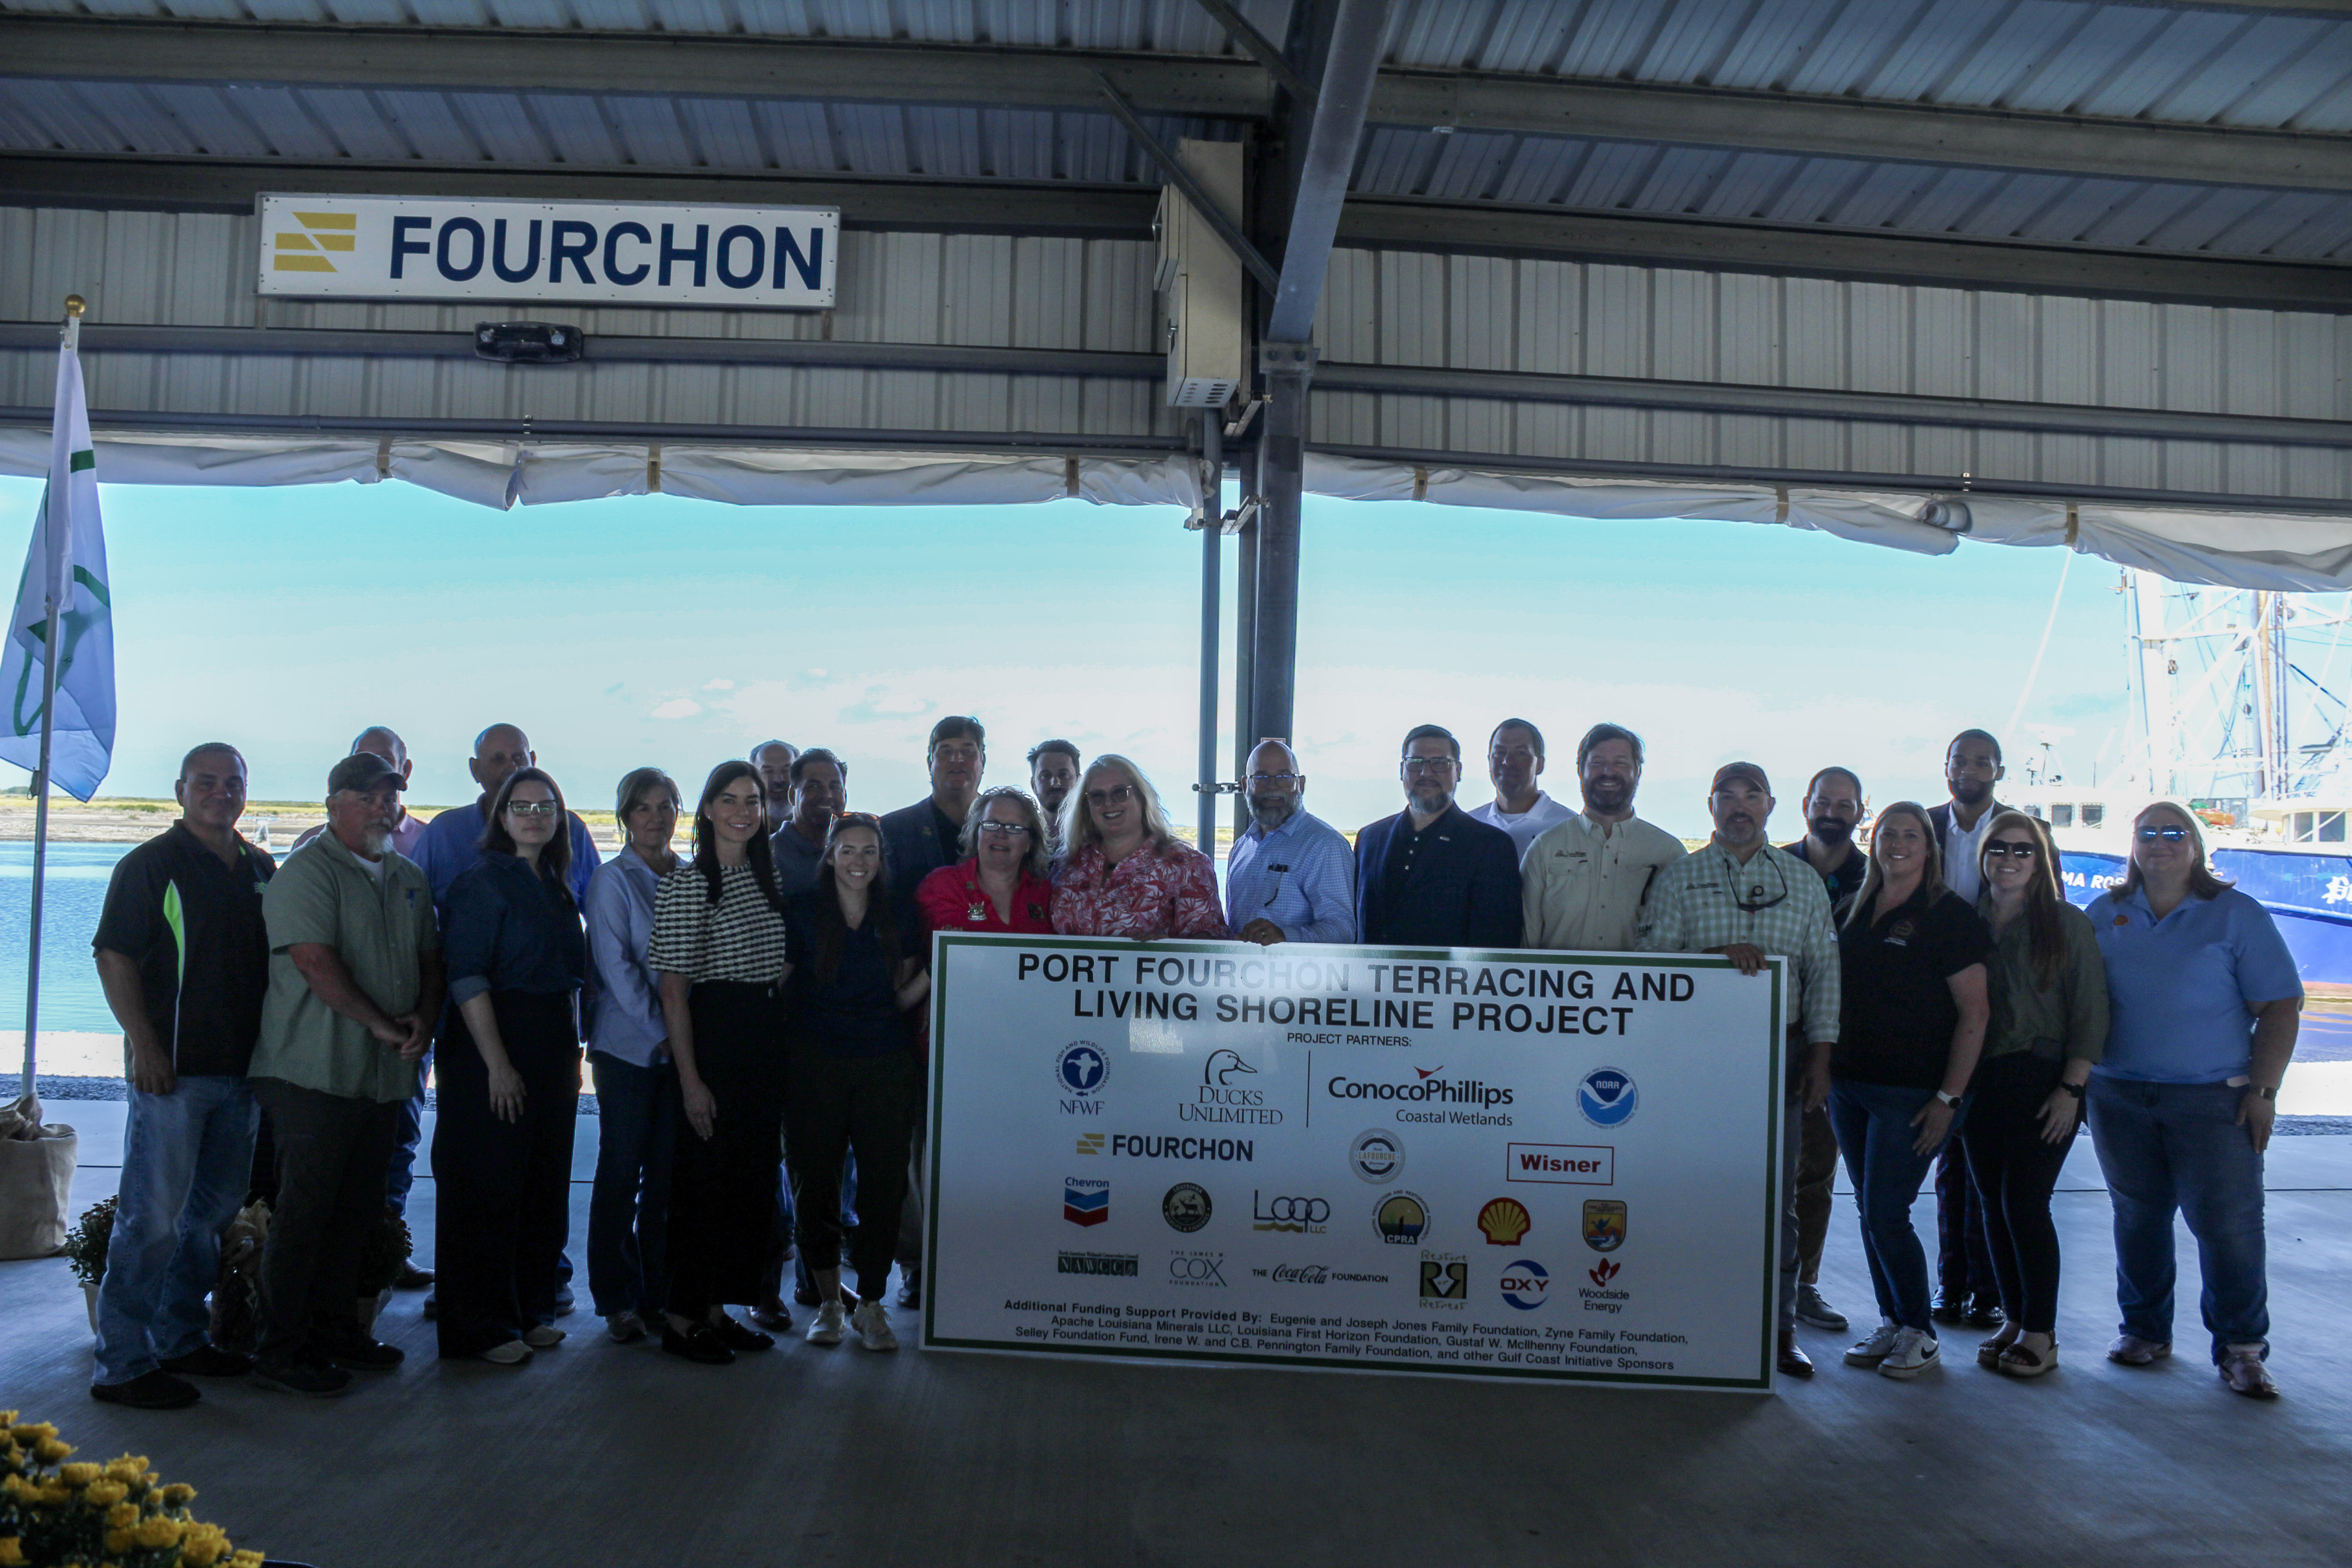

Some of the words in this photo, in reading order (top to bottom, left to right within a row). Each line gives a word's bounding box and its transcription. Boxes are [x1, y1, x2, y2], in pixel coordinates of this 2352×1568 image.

[390, 215, 823, 290] FOURCHON
[1019, 953, 1119, 983] PORT
[1136, 957, 1349, 991] FOURCHON
[1367, 964, 1594, 1000] TERRACING
[1612, 972, 1695, 1002] AND
[1074, 989, 1198, 1021] LIVING
[1215, 994, 1434, 1029] SHORELINE
[1453, 1002, 1633, 1035] PROJECT
[1065, 1041, 1078, 1050] AND
[1079, 1040, 1106, 1056] WILDLIFE
[1287, 1033, 1342, 1044] PROJECT
[1347, 1035, 1412, 1047] PARTNERS:
[1056, 1049, 1065, 1063] FISH
[1055, 1065, 1073, 1094] NATIONAL
[1091, 1057, 1111, 1094] FOUNDATION
[1596, 1080, 1620, 1089] NOAA
[1199, 1086, 1263, 1106] DUCKS
[1328, 1077, 1514, 1110] ConocoPhillips
[1060, 1099, 1105, 1116] NFWF
[1179, 1103, 1283, 1125] UNLIMITED
[1396, 1109, 1446, 1123] Coastal
[1449, 1111, 1513, 1126] Wetlands
[1112, 1134, 1253, 1162] FOURCHON
[1358, 1152, 1396, 1161] LAFOURCHE
[1520, 1154, 1602, 1173] Wisner
[1065, 1176, 1109, 1188] Chevron
[1173, 1184, 1203, 1194] LOUISIANA
[1387, 1235, 1415, 1244] CPRA
[1170, 1257, 1227, 1287] COX
[1332, 1273, 1388, 1283] FOUNDATION
[1500, 1278, 1549, 1292] OXY
[1578, 1287, 1630, 1300] Woodside
[1584, 1300, 1622, 1313] Energy
[1004, 1300, 1066, 1313] Additional
[1072, 1303, 1121, 1316] Funding
[1126, 1306, 1176, 1319] Support
[1181, 1308, 1237, 1321] Provided
[1242, 1312, 1262, 1324] By:
[1270, 1313, 1316, 1326] Eugenie
[1320, 1317, 1342, 1327] and
[1346, 1318, 1387, 1331] Joseph
[1392, 1319, 1427, 1331] Jones
[1432, 1322, 1468, 1335] Family
[1473, 1323, 1540, 1338] Foundation,
[1545, 1327, 1573, 1339] Zyne
[1579, 1329, 1615, 1342] Family
[1620, 1331, 1688, 1345] Foundation,
[1051, 1315, 1094, 1328] Apache
[1098, 1318, 1152, 1330] Louisiana
[1156, 1321, 1203, 1333] Minerals
[1208, 1323, 1232, 1335] LLC,
[1238, 1325, 1291, 1337] Louisiana
[1296, 1328, 1320, 1339] First
[1326, 1330, 1370, 1341] Horizon
[1375, 1332, 1441, 1346] Foundation,
[1446, 1335, 1485, 1347] Gustaf
[1489, 1338, 1502, 1348] W.
[1507, 1339, 1565, 1353] McIlhenny
[1570, 1342, 1637, 1356] Foundation,
[1015, 1327, 1048, 1339] Selley
[1053, 1328, 1115, 1341] Foundation
[1120, 1332, 1150, 1344] Fund,
[1155, 1334, 1182, 1345] Irene
[1187, 1336, 1200, 1346] W.
[1205, 1337, 1225, 1347] and
[1231, 1338, 1252, 1348] C.B.
[1257, 1339, 1320, 1353] Pennington
[1325, 1343, 1361, 1357] Family
[1366, 1345, 1432, 1359] Foundation,
[1437, 1350, 1459, 1359] and
[1464, 1351, 1494, 1361] other
[1498, 1352, 1522, 1363] Gulf
[1526, 1353, 1560, 1364] Coast
[1565, 1355, 1612, 1367] Initiative
[1617, 1357, 1674, 1370] Sponsors
